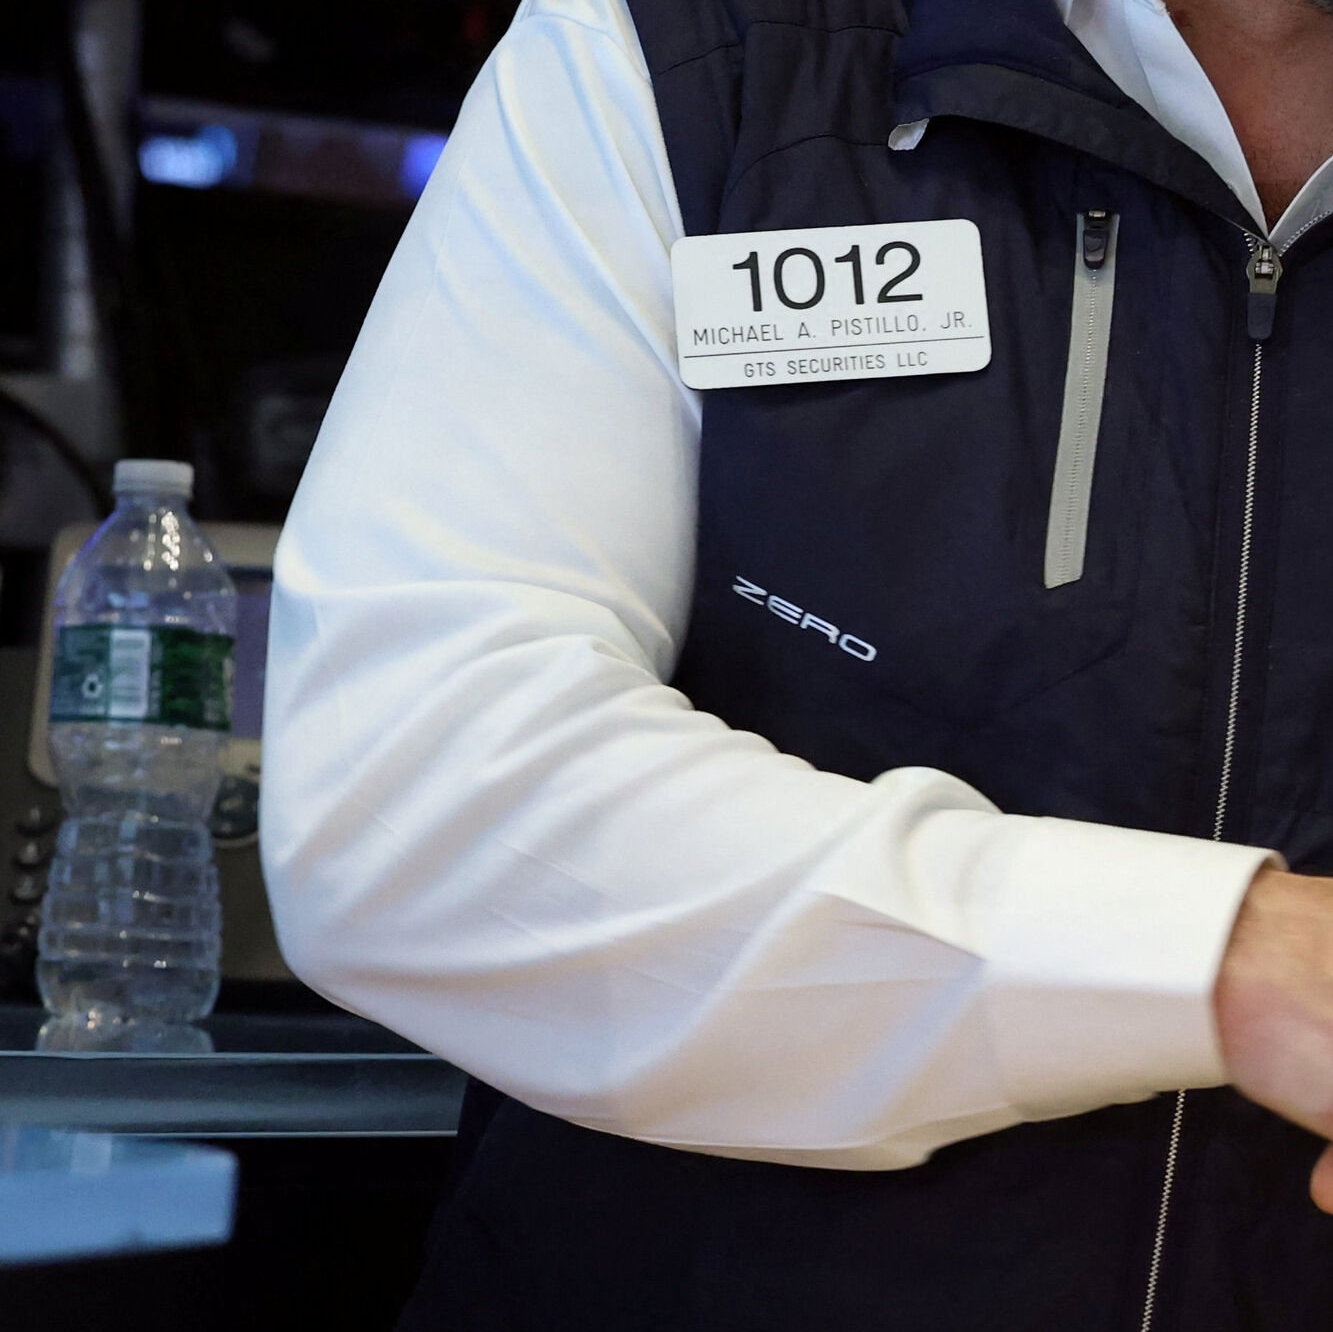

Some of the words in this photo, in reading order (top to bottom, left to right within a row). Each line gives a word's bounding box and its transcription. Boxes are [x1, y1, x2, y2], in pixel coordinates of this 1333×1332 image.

[731, 240, 925, 313] 1012
[692, 322, 784, 347] MICHAEL
[797, 321, 817, 340] A.
[939, 311, 973, 330] JR.
[743, 360, 776, 379] GTS
[786, 353, 887, 377] SECURITIES
[897, 350, 929, 368] LLC
[732, 575, 878, 662] ZERO
